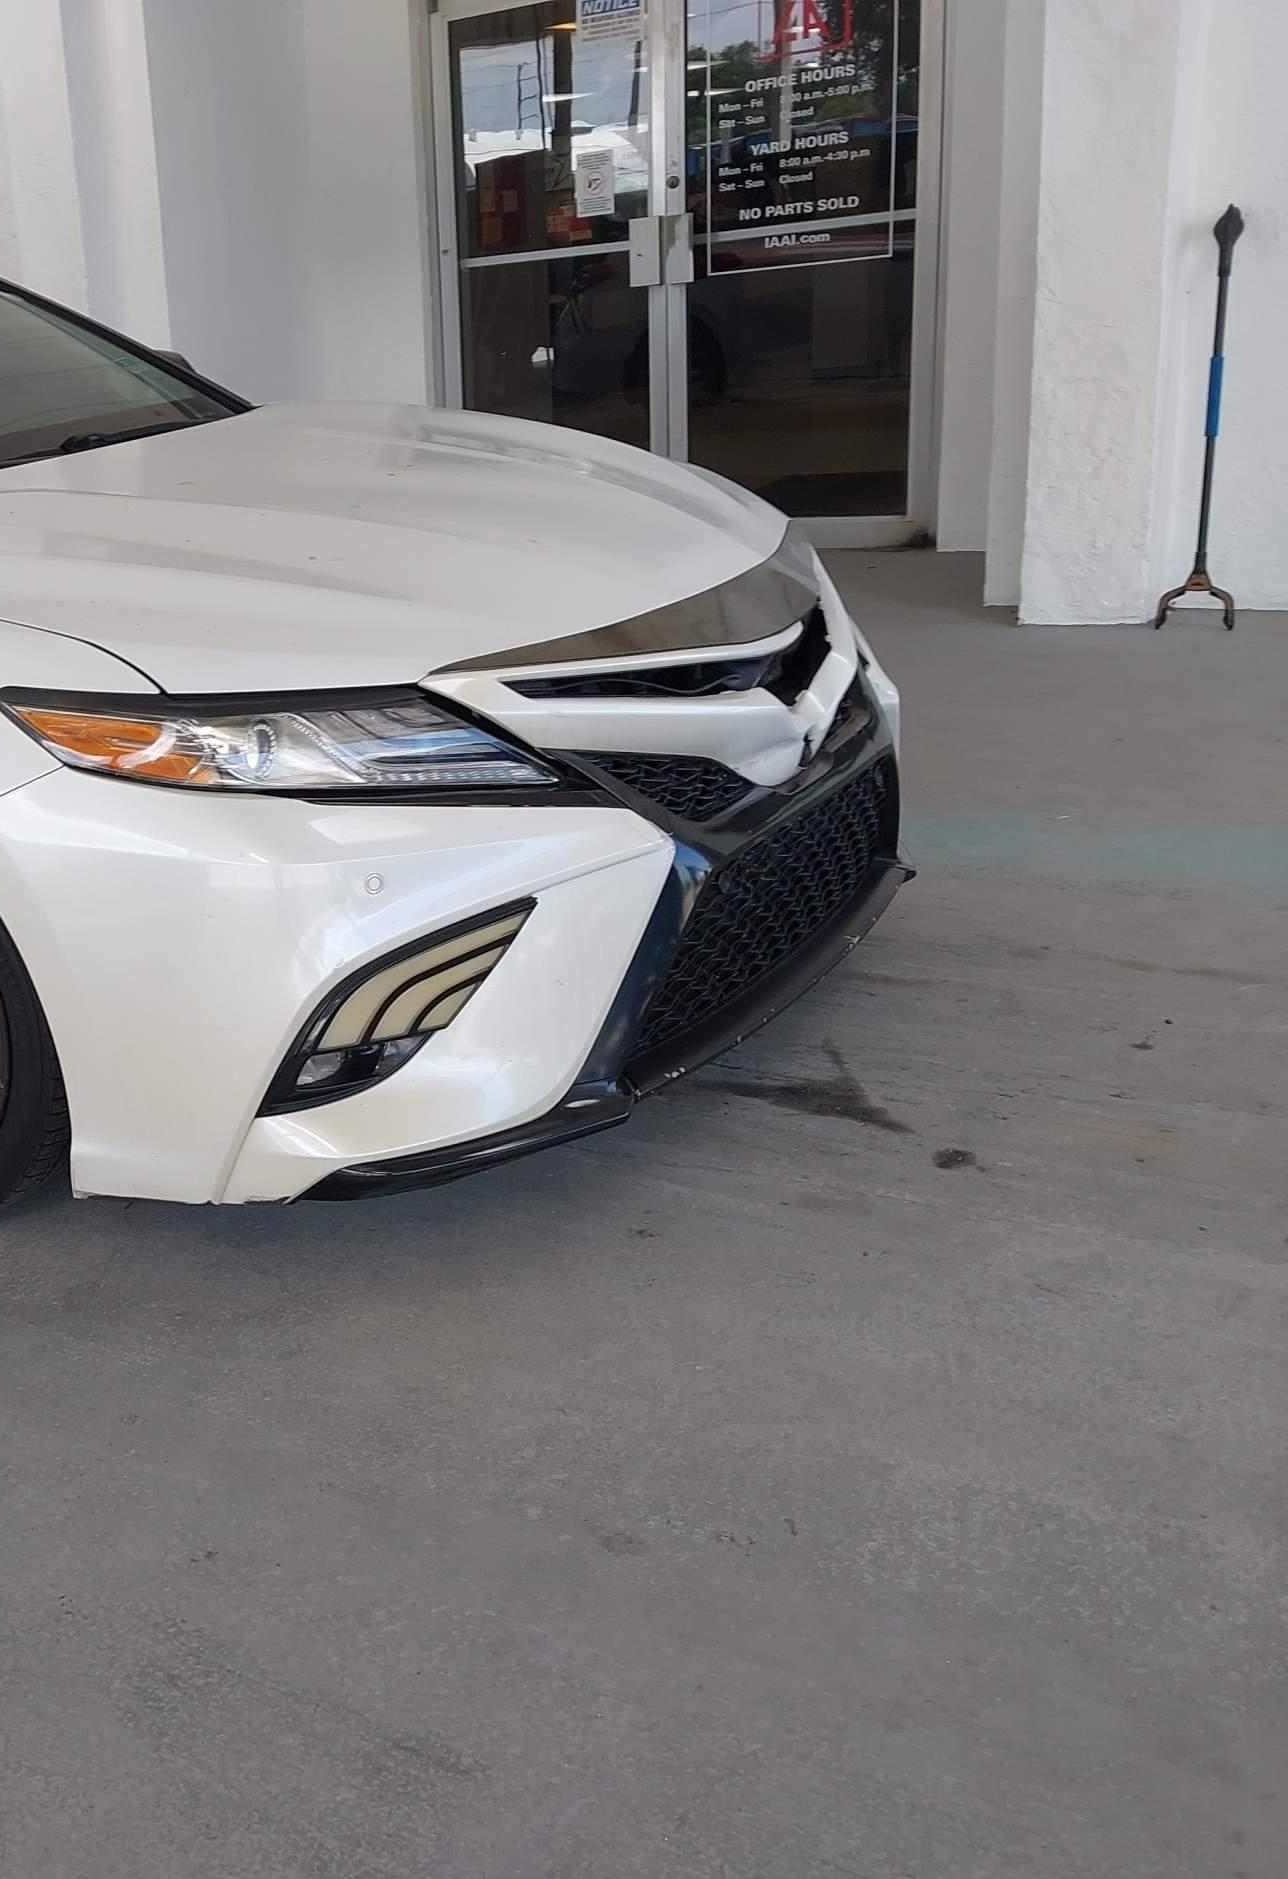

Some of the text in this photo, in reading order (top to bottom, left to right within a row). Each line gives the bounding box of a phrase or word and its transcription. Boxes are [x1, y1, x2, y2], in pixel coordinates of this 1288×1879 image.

[745, 64, 856, 92] OFFICE HOURS
[719, 103, 741, 113] Mon
[751, 98, 764, 108] Fri
[745, 115, 765, 125] Sun
[780, 107, 814, 119] Cosed
[751, 132, 849, 156] YARD HOURS
[719, 167, 741, 176] Mon
[750, 163, 764, 172] Fri
[779, 157, 801, 168] 8:00
[719, 182, 736, 192] Sat
[745, 179, 765, 189] Sun
[779, 171, 813, 184] Closed
[739, 196, 860, 221] NO PARTS SOLD
[764, 233, 831, 249] IAAI.com
